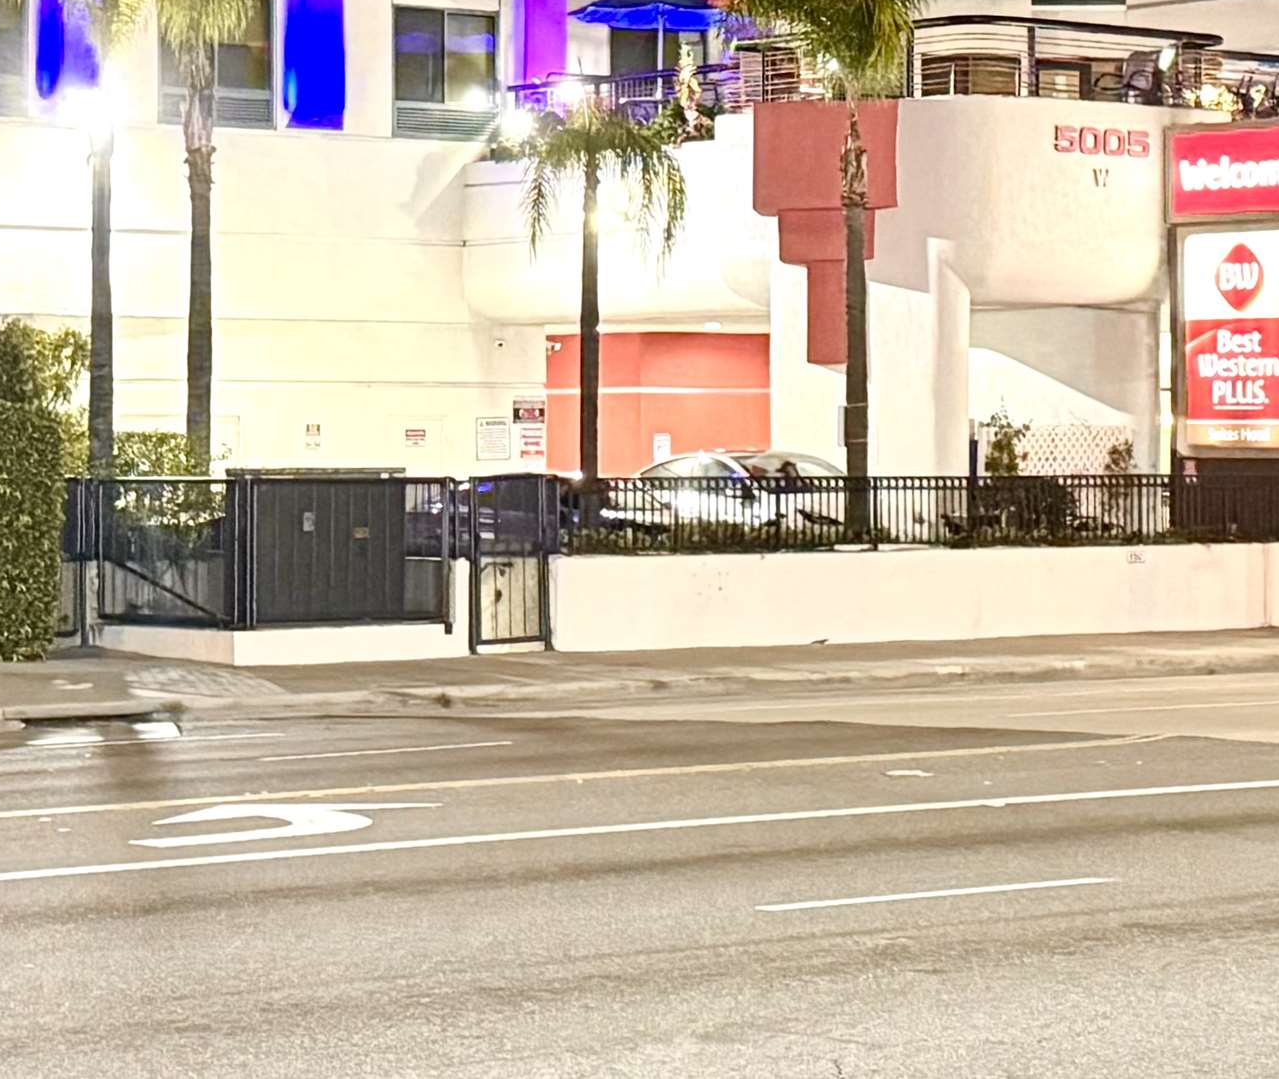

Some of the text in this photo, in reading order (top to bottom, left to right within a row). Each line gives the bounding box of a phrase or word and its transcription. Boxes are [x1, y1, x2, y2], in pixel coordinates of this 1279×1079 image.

[1054, 125, 1150, 158] 5005
[1221, 262, 1259, 291] BW
[1217, 329, 1262, 353] Best
